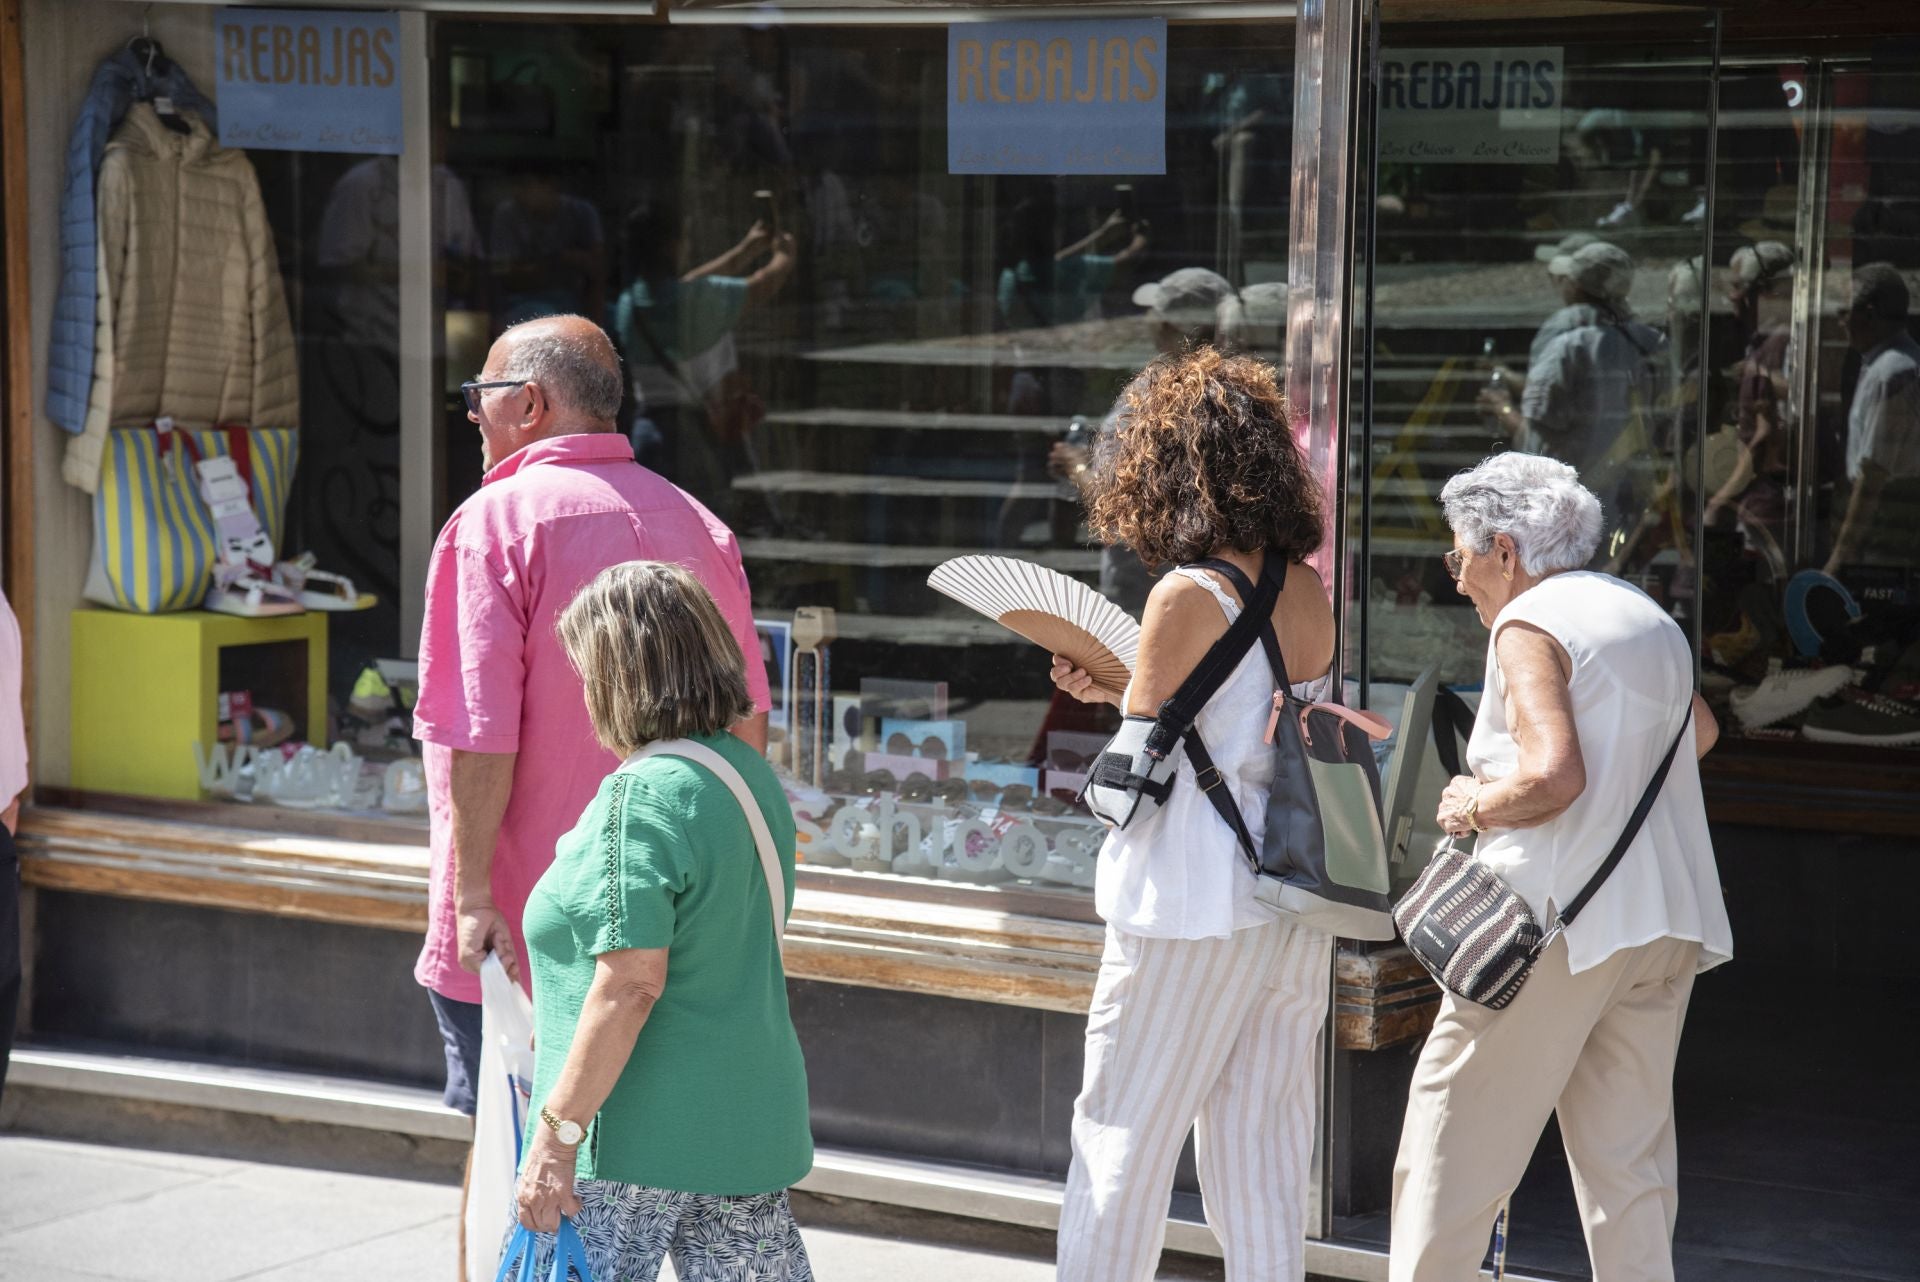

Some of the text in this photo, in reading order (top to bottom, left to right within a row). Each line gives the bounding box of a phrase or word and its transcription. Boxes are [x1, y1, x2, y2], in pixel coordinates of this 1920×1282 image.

[222, 24, 395, 88] REBAJAS
[957, 36, 1159, 104] REBAJAS
[1381, 59, 1556, 110] REBAJAS
[1863, 587, 1894, 600] FAST
